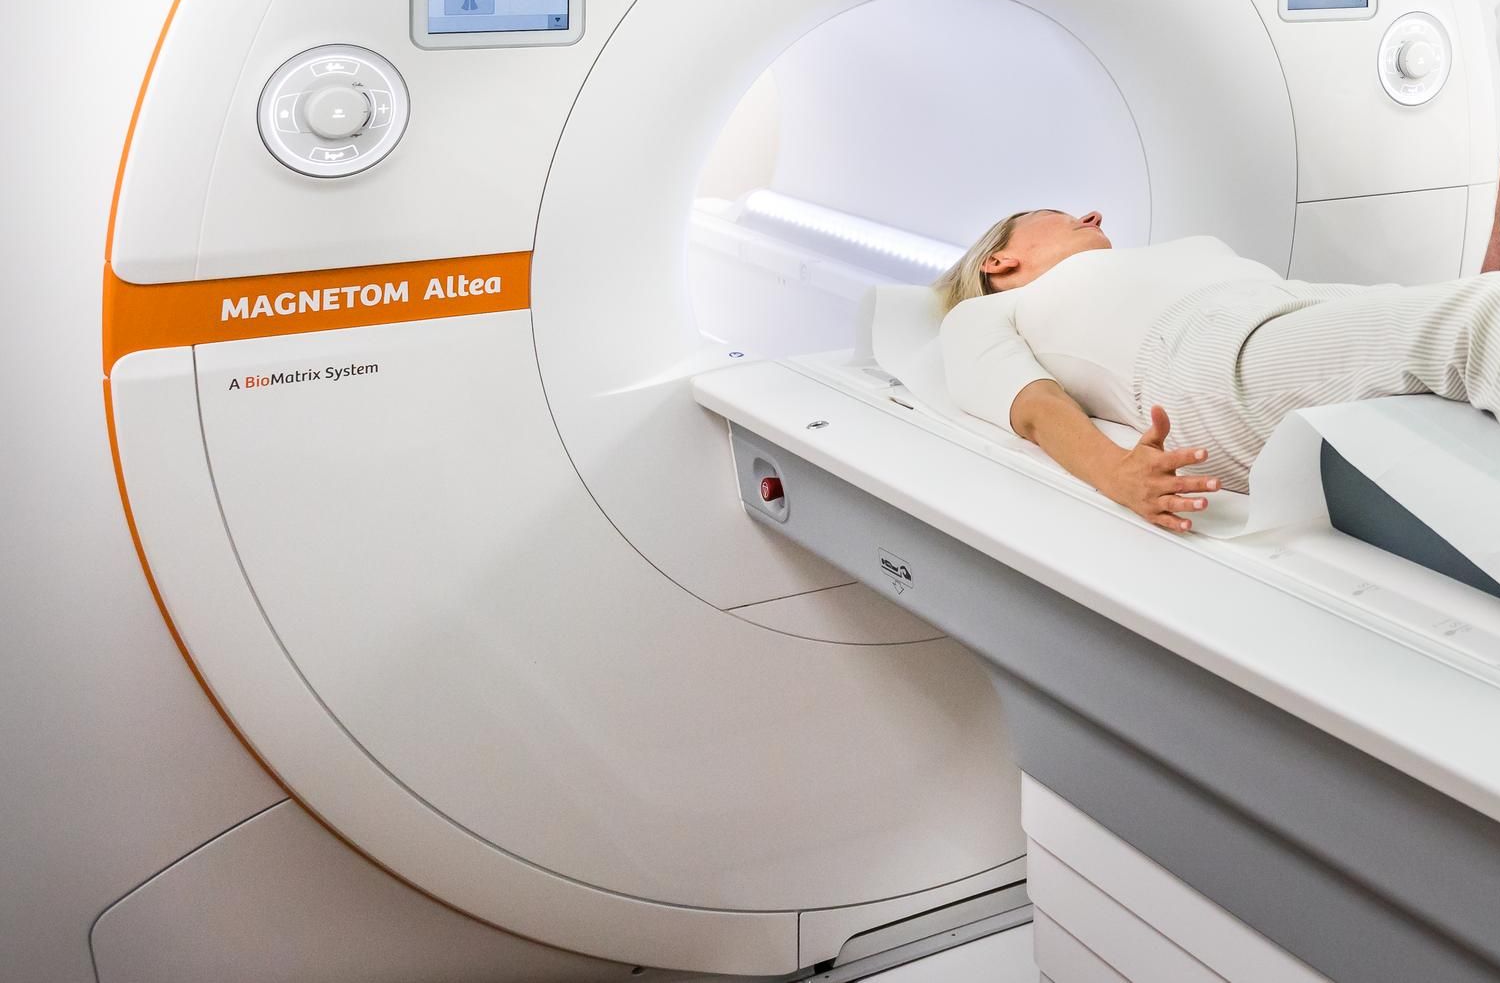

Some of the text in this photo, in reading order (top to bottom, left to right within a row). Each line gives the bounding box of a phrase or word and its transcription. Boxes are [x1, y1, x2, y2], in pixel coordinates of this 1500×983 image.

[220, 274, 502, 322] MAGNETOM Altea
[228, 364, 379, 391] A BioMatrix System
